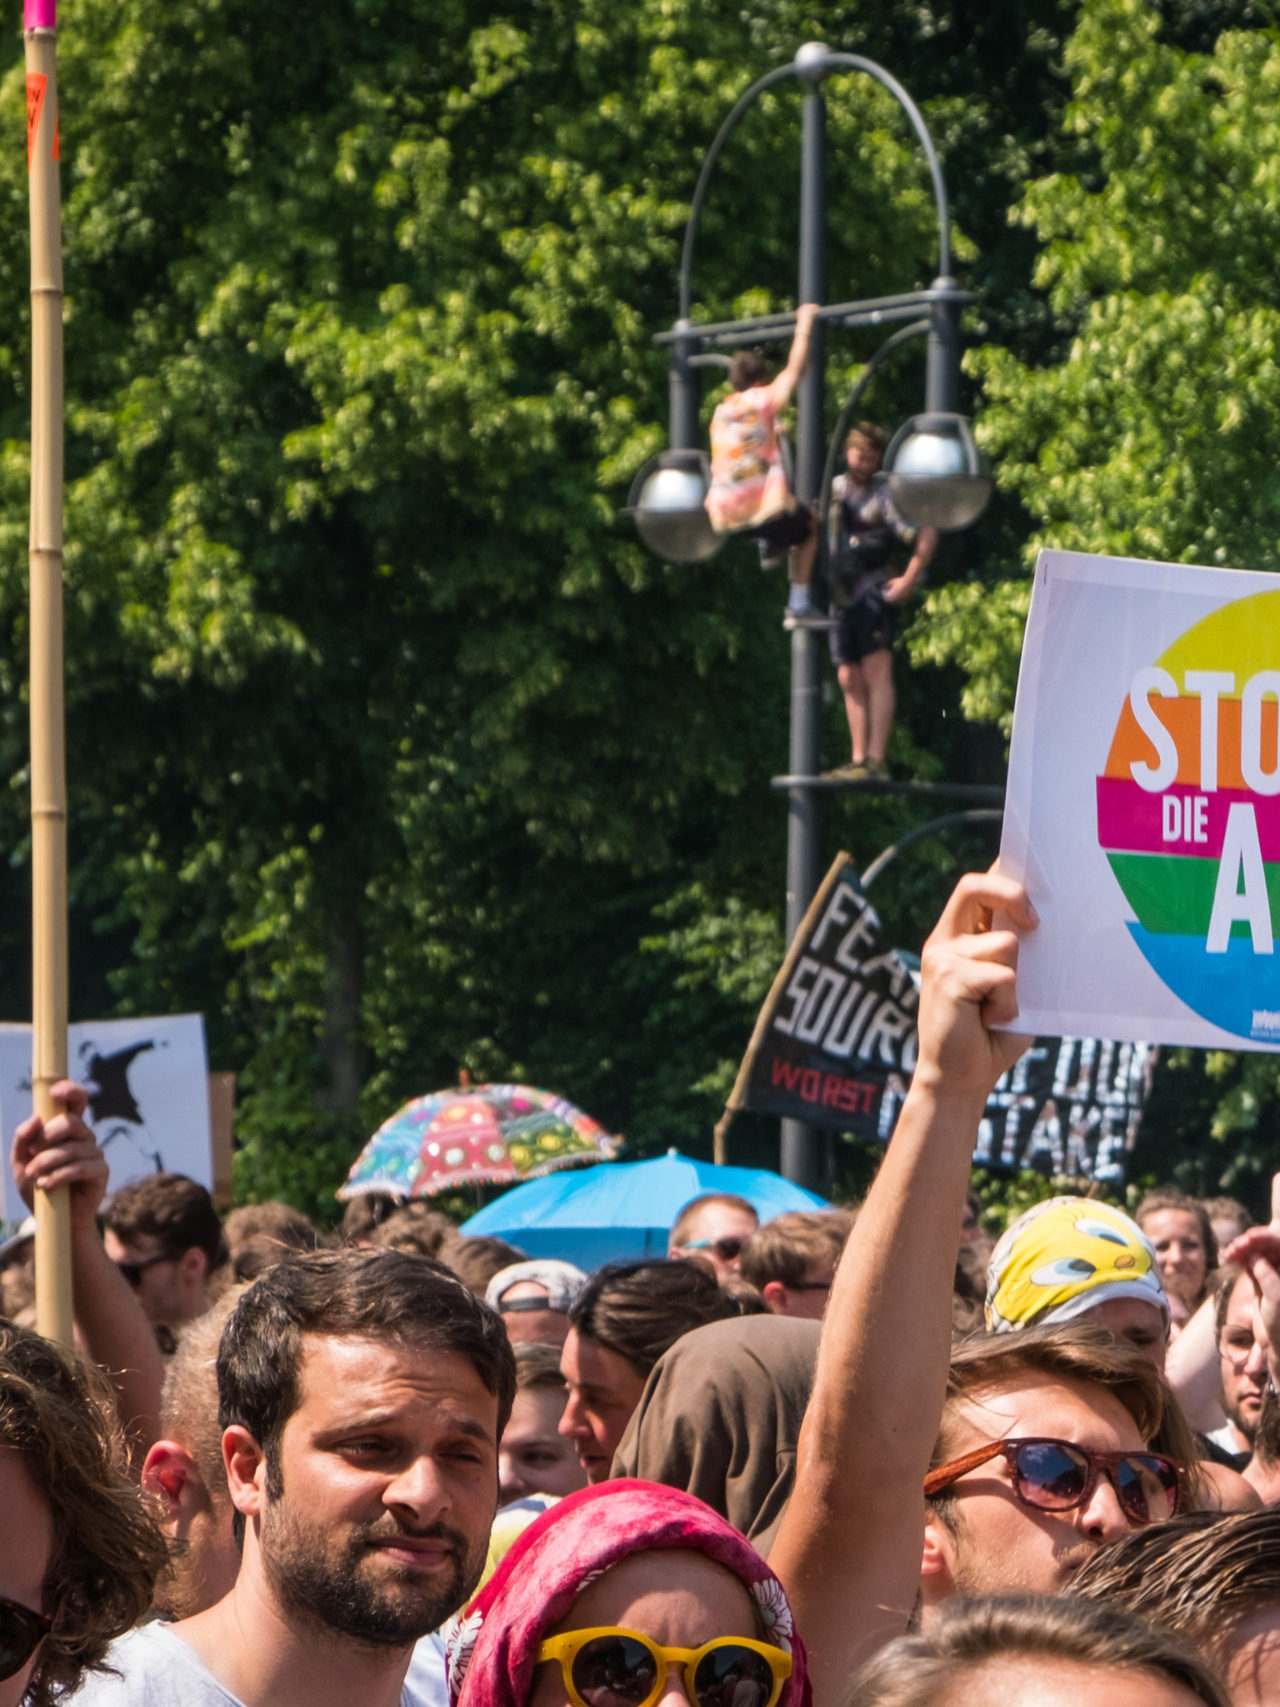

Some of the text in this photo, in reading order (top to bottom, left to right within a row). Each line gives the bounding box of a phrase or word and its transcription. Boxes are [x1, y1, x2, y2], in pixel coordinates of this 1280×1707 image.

[1162, 795, 1209, 843] DIE
[810, 882, 920, 1008] FEA
[770, 1056, 878, 1116] WORST
